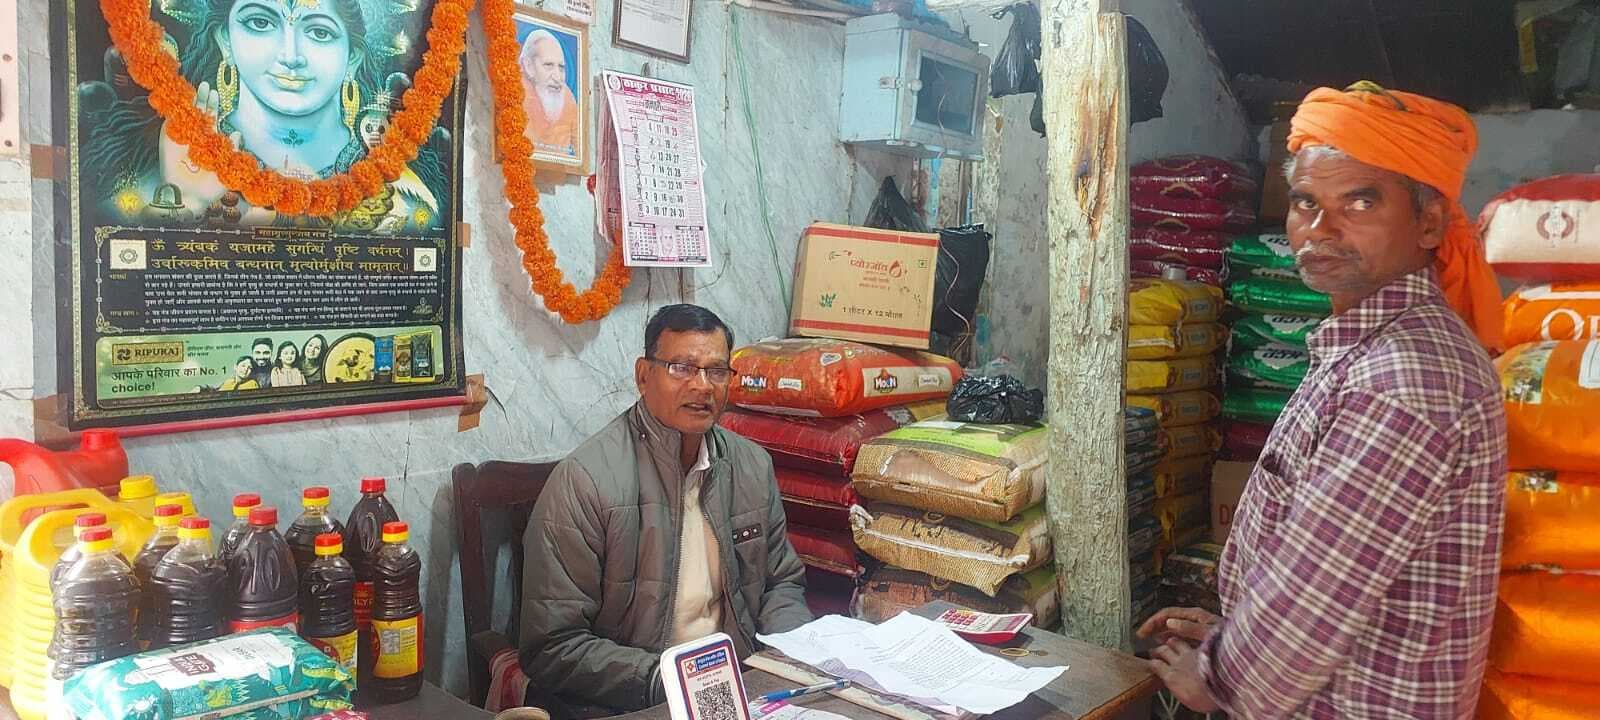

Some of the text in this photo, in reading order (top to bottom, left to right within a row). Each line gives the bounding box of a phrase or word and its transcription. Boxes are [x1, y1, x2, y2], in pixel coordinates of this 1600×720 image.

[667, 168, 673, 176] 21
[662, 207, 668, 216] 17
[228, 240, 276, 254] यजामहे
[334, 243, 360, 258] पुष्टि
[367, 244, 404, 259] वर्धनम्
[236, 260, 288, 273] बन्धनान्
[134, 348, 179, 357] RIPURAJ
[112, 366, 226, 380] आपके परिवार का No. 1
[112, 382, 155, 394] choice!
